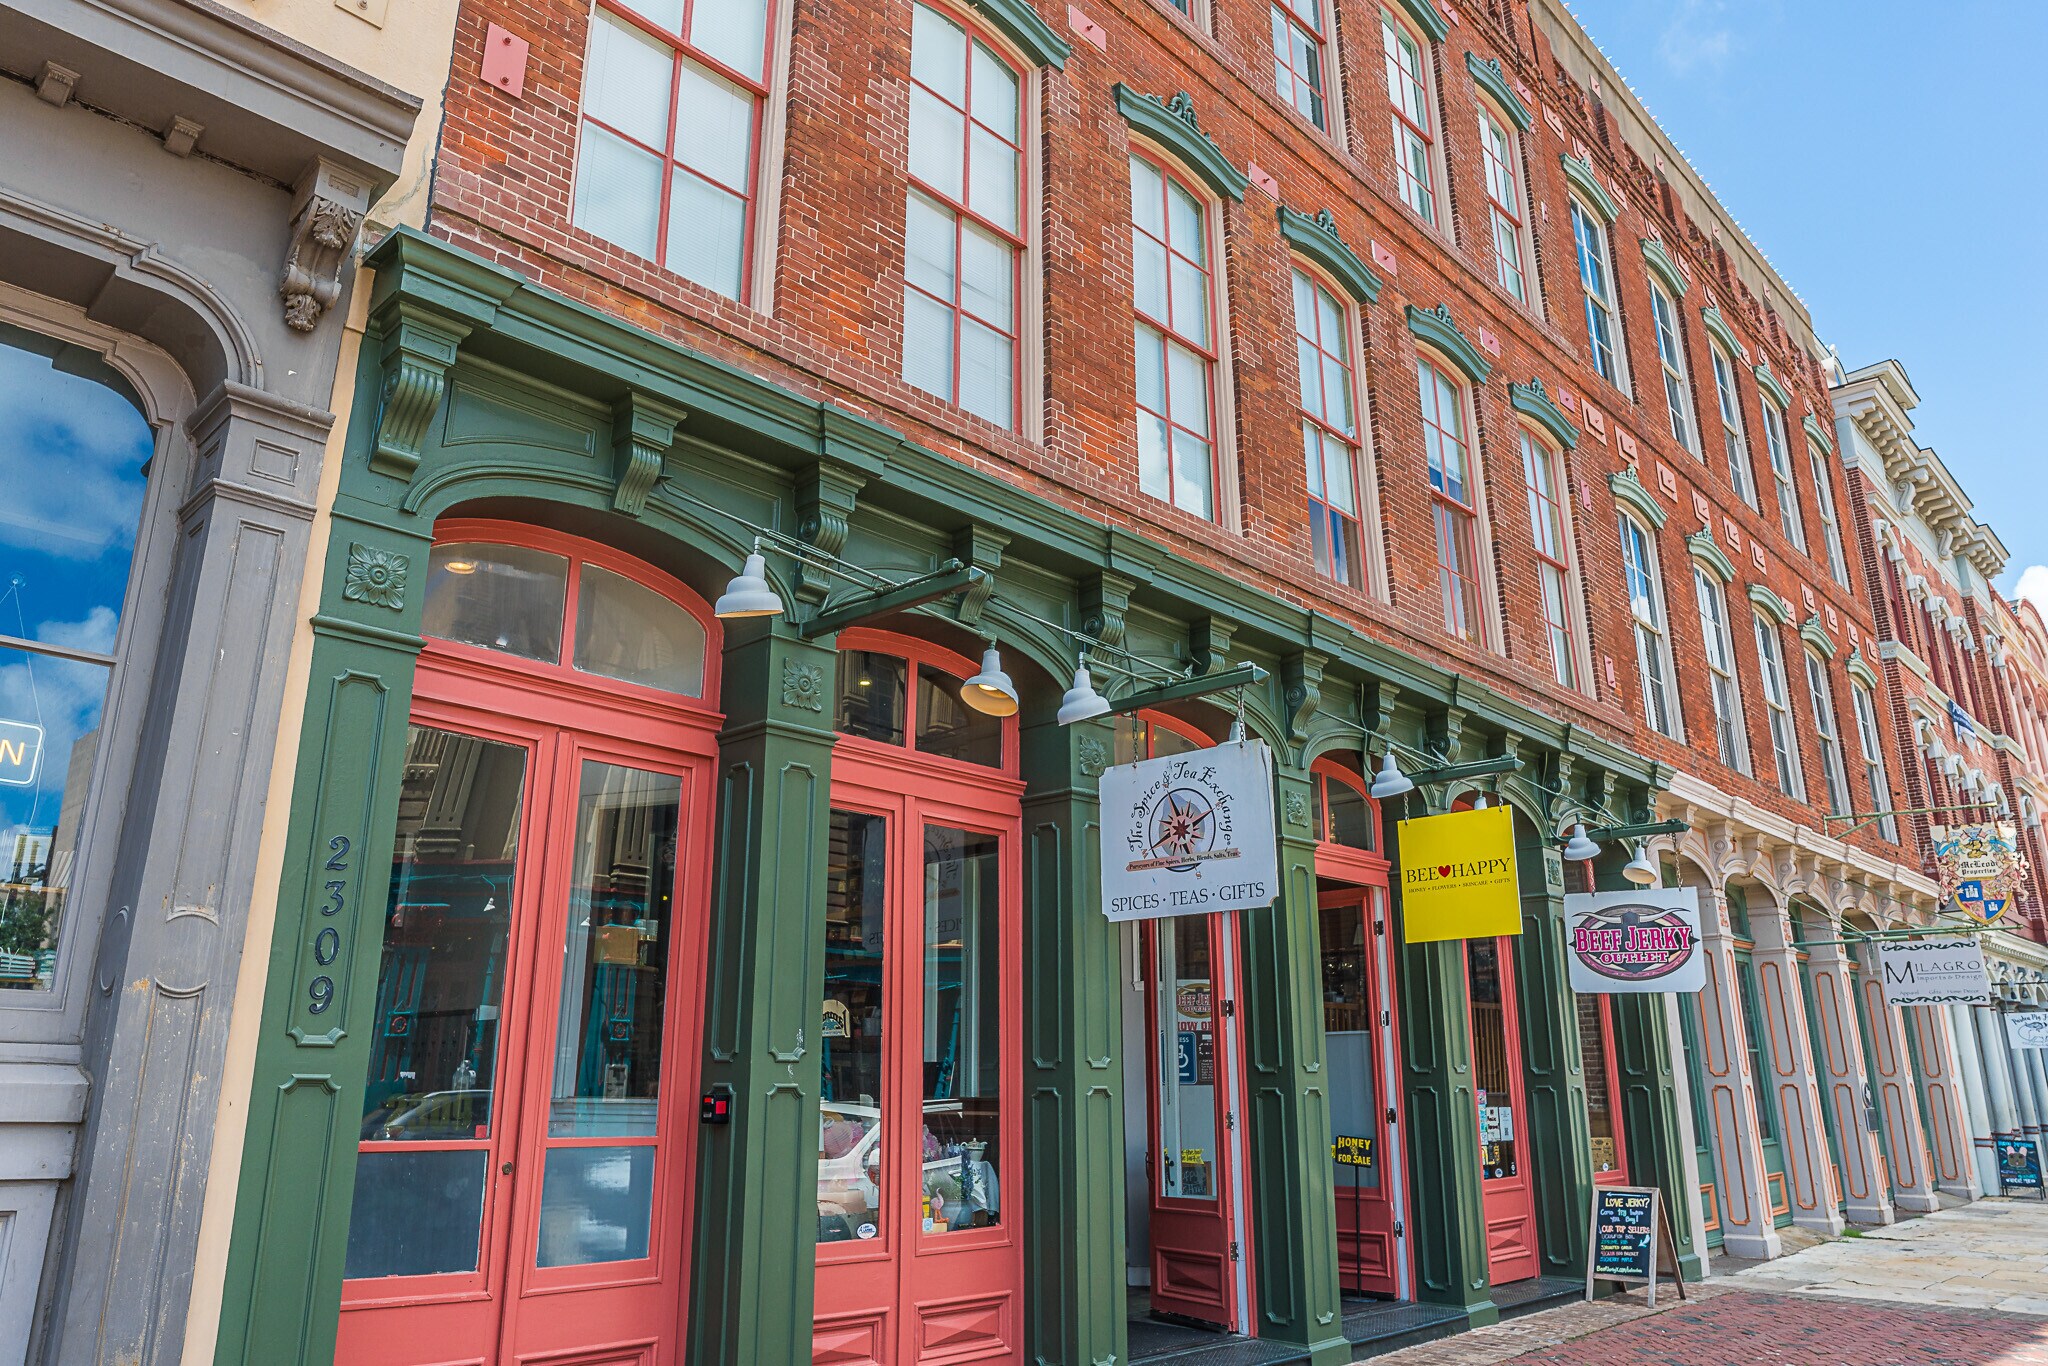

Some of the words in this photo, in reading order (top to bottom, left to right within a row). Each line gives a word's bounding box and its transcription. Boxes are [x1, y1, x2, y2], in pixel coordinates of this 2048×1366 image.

[1173, 761, 1198, 780] Tea
[1131, 781, 1161, 819] Spice
[1126, 821, 1144, 853] The
[1406, 866, 1440, 883] BEE
[1451, 858, 1511, 878] HAPPY
[1111, 893, 1160, 913] SPICES
[1169, 888, 1209, 906] TEAS
[1218, 882, 1265, 902] GIFTS
[1574, 928, 1622, 953] BEEF
[1624, 925, 1692, 951] JERKY
[1600, 951, 1669, 964] OUTLET
[1884, 960, 1981, 984] MILAGRO
[1954, 973, 1983, 981] Design
[1337, 1136, 1371, 1150] HONEY
[1337, 1154, 1351, 1163] FOR
[1352, 1155, 1371, 1165] SALE
[1625, 1197, 1650, 1208] JERKY?
[1601, 1225, 1614, 1233] OUR
[1615, 1225, 1626, 1233] TOP
